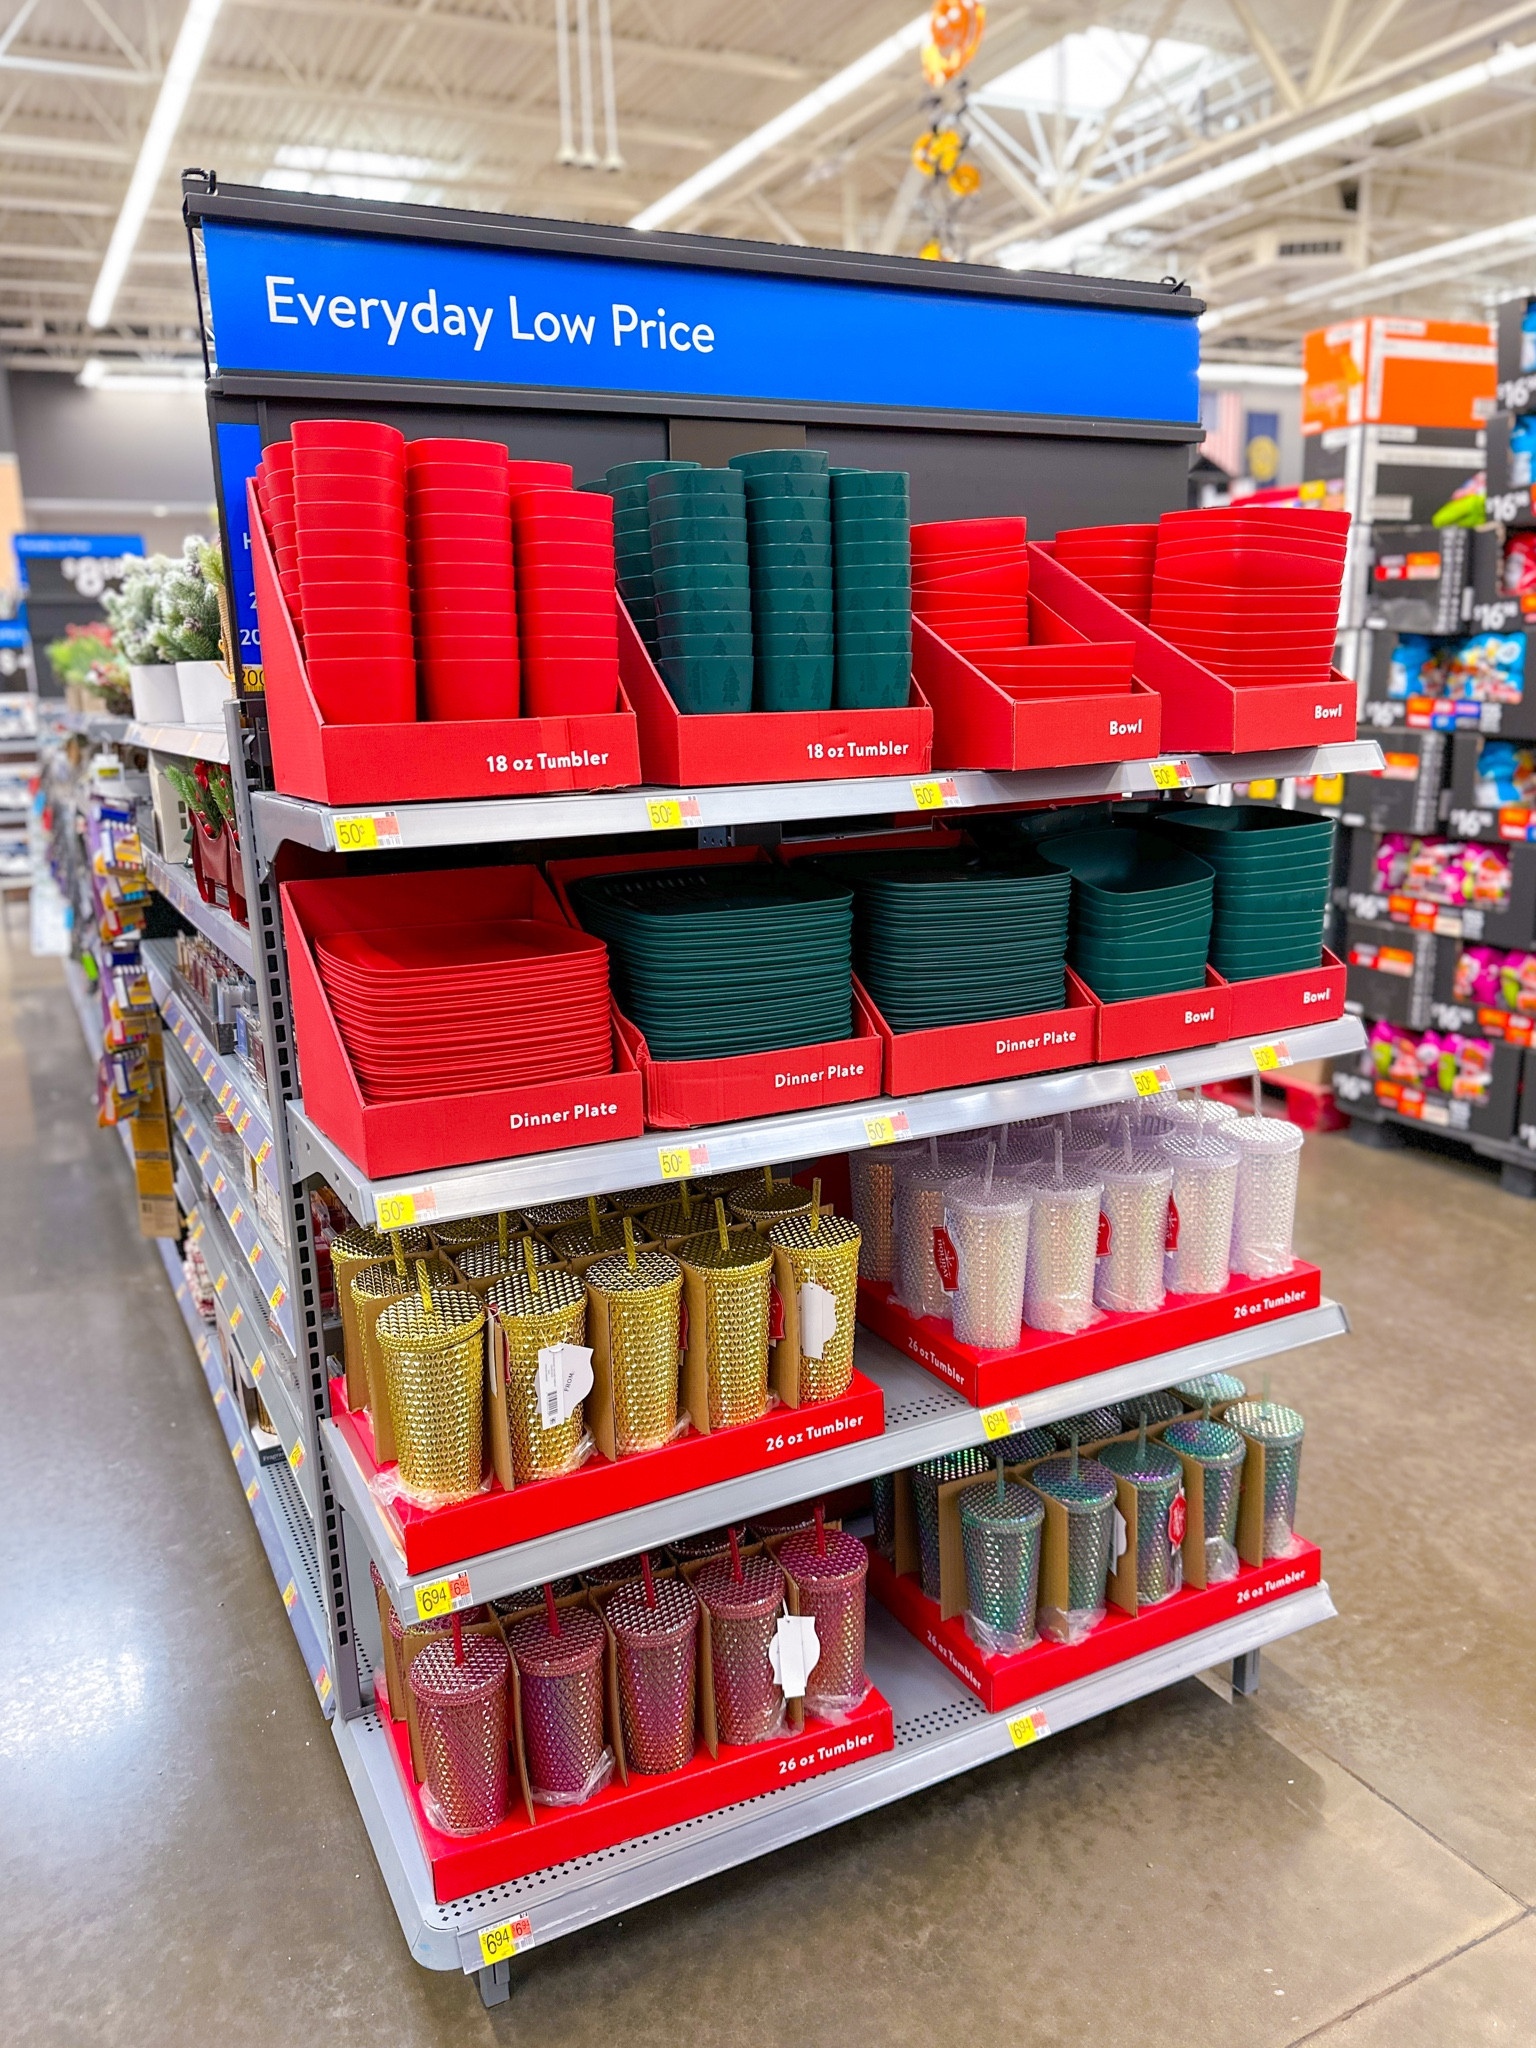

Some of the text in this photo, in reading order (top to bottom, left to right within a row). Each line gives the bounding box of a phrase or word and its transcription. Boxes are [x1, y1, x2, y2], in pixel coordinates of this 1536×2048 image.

[266, 275, 715, 353] Everyday Low Price
[1314, 703, 1343, 719] Bowl
[1109, 719, 1142, 735] Bowl
[486, 750, 609, 772] 18 oz Tumbler
[807, 741, 909, 759] 18 oz Tumbler
[1303, 988, 1331, 1004] Bowl
[1184, 1008, 1214, 1024] Bowl
[996, 1030, 1076, 1054] Dinner Plate
[775, 1064, 864, 1088] Dinner Plate
[510, 1102, 618, 1129] Dinner Plate
[1234, 1290, 1306, 1319] 26 oz Tumbler
[908, 1336, 965, 1385] 26 oz Tumbler
[766, 1415, 863, 1452] 26 oz Tumbler
[1237, 1569, 1306, 1604] 26 oz Tumbler
[927, 1630, 937, 1647] 26
[948, 1649, 981, 1690] Tumbler
[779, 1733, 874, 1775] 26 oz Tumbler
